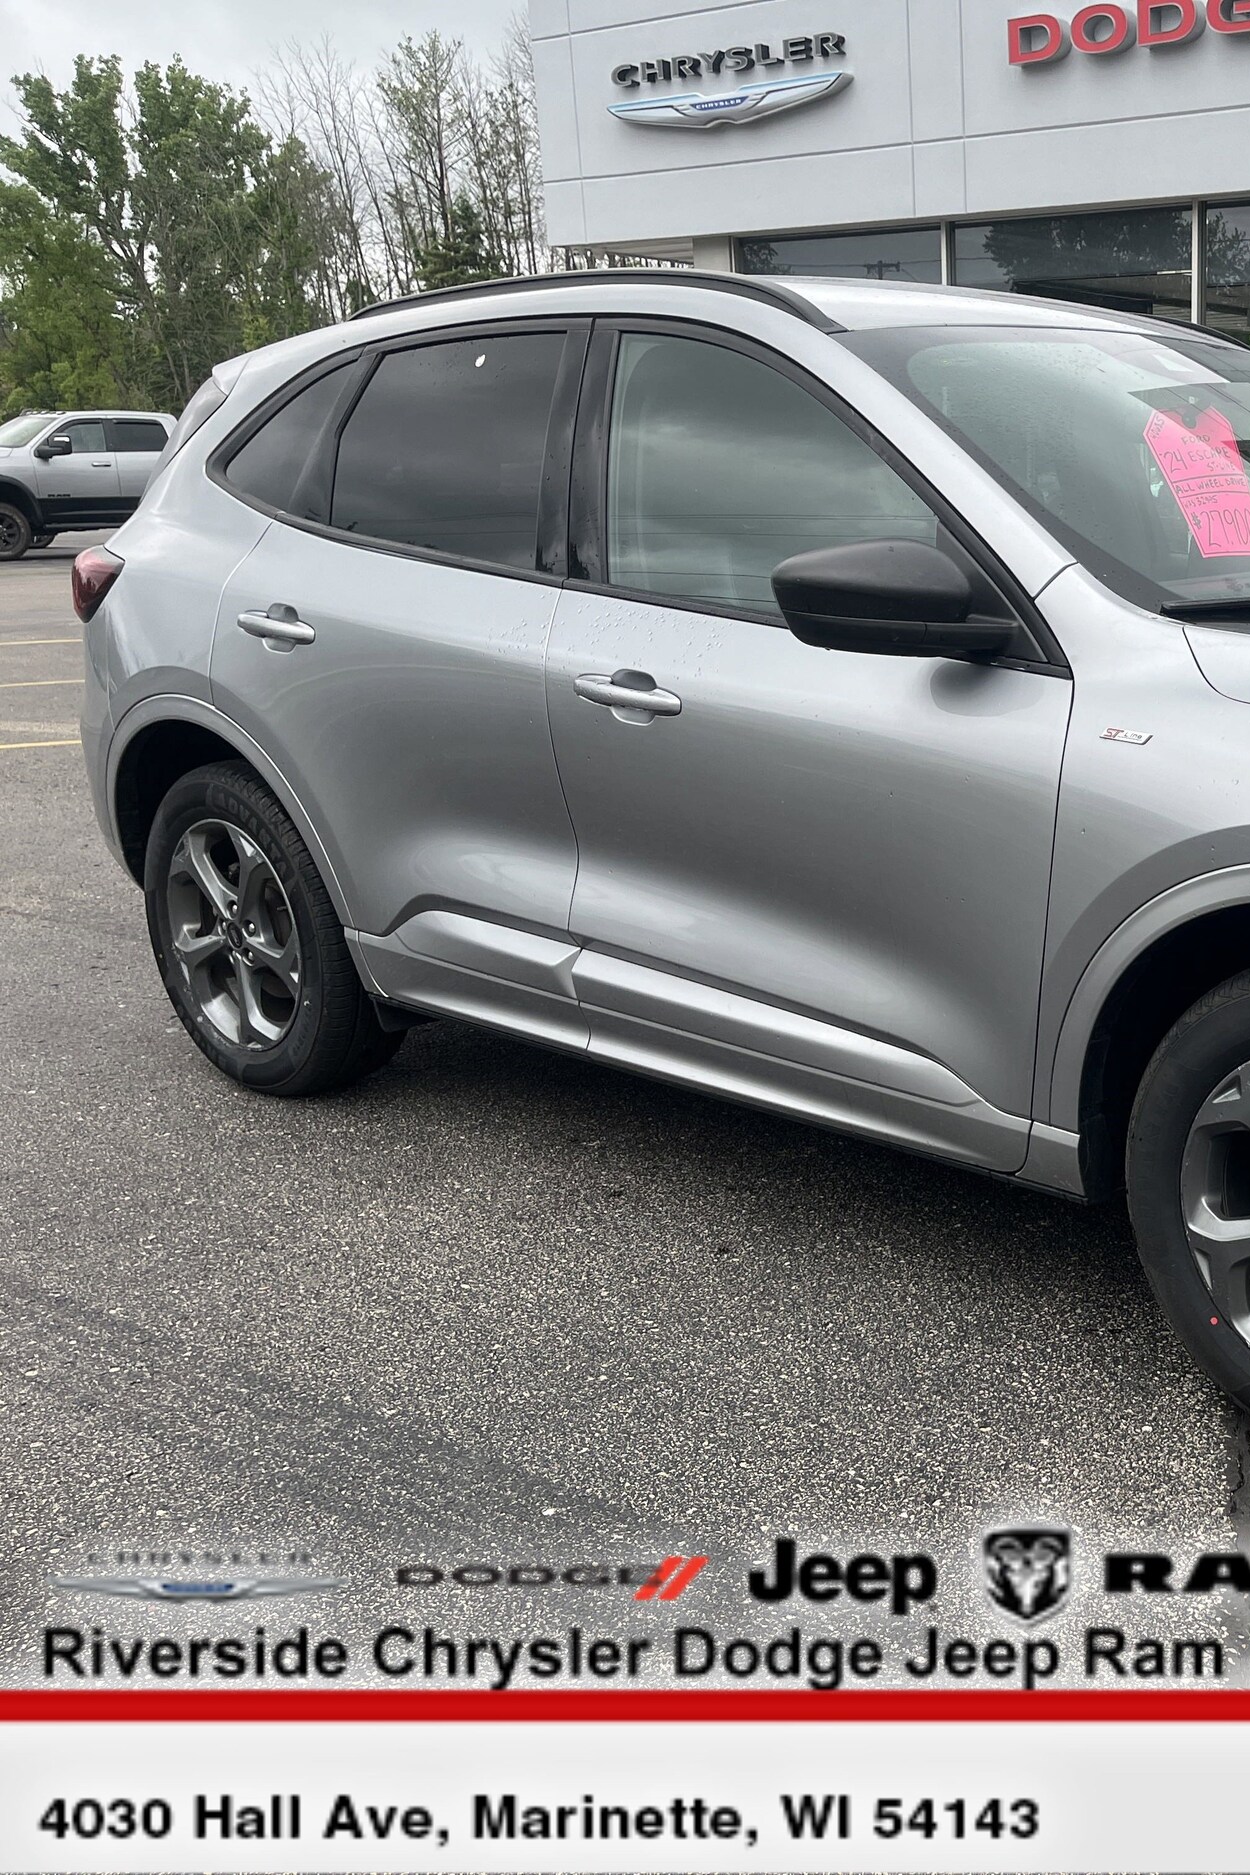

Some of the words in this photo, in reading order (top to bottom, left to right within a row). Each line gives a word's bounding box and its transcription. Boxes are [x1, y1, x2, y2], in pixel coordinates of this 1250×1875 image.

[611, 32, 846, 87] CHRYSLER
[695, 99, 741, 110] CHRYSLER
[1181, 434, 1211, 445] FORD
[1188, 446, 1231, 462] ESCAPE
[1175, 483, 1195, 494] ALL
[1197, 479, 1224, 490] WHEEL
[1225, 477, 1247, 486] DRIVE
